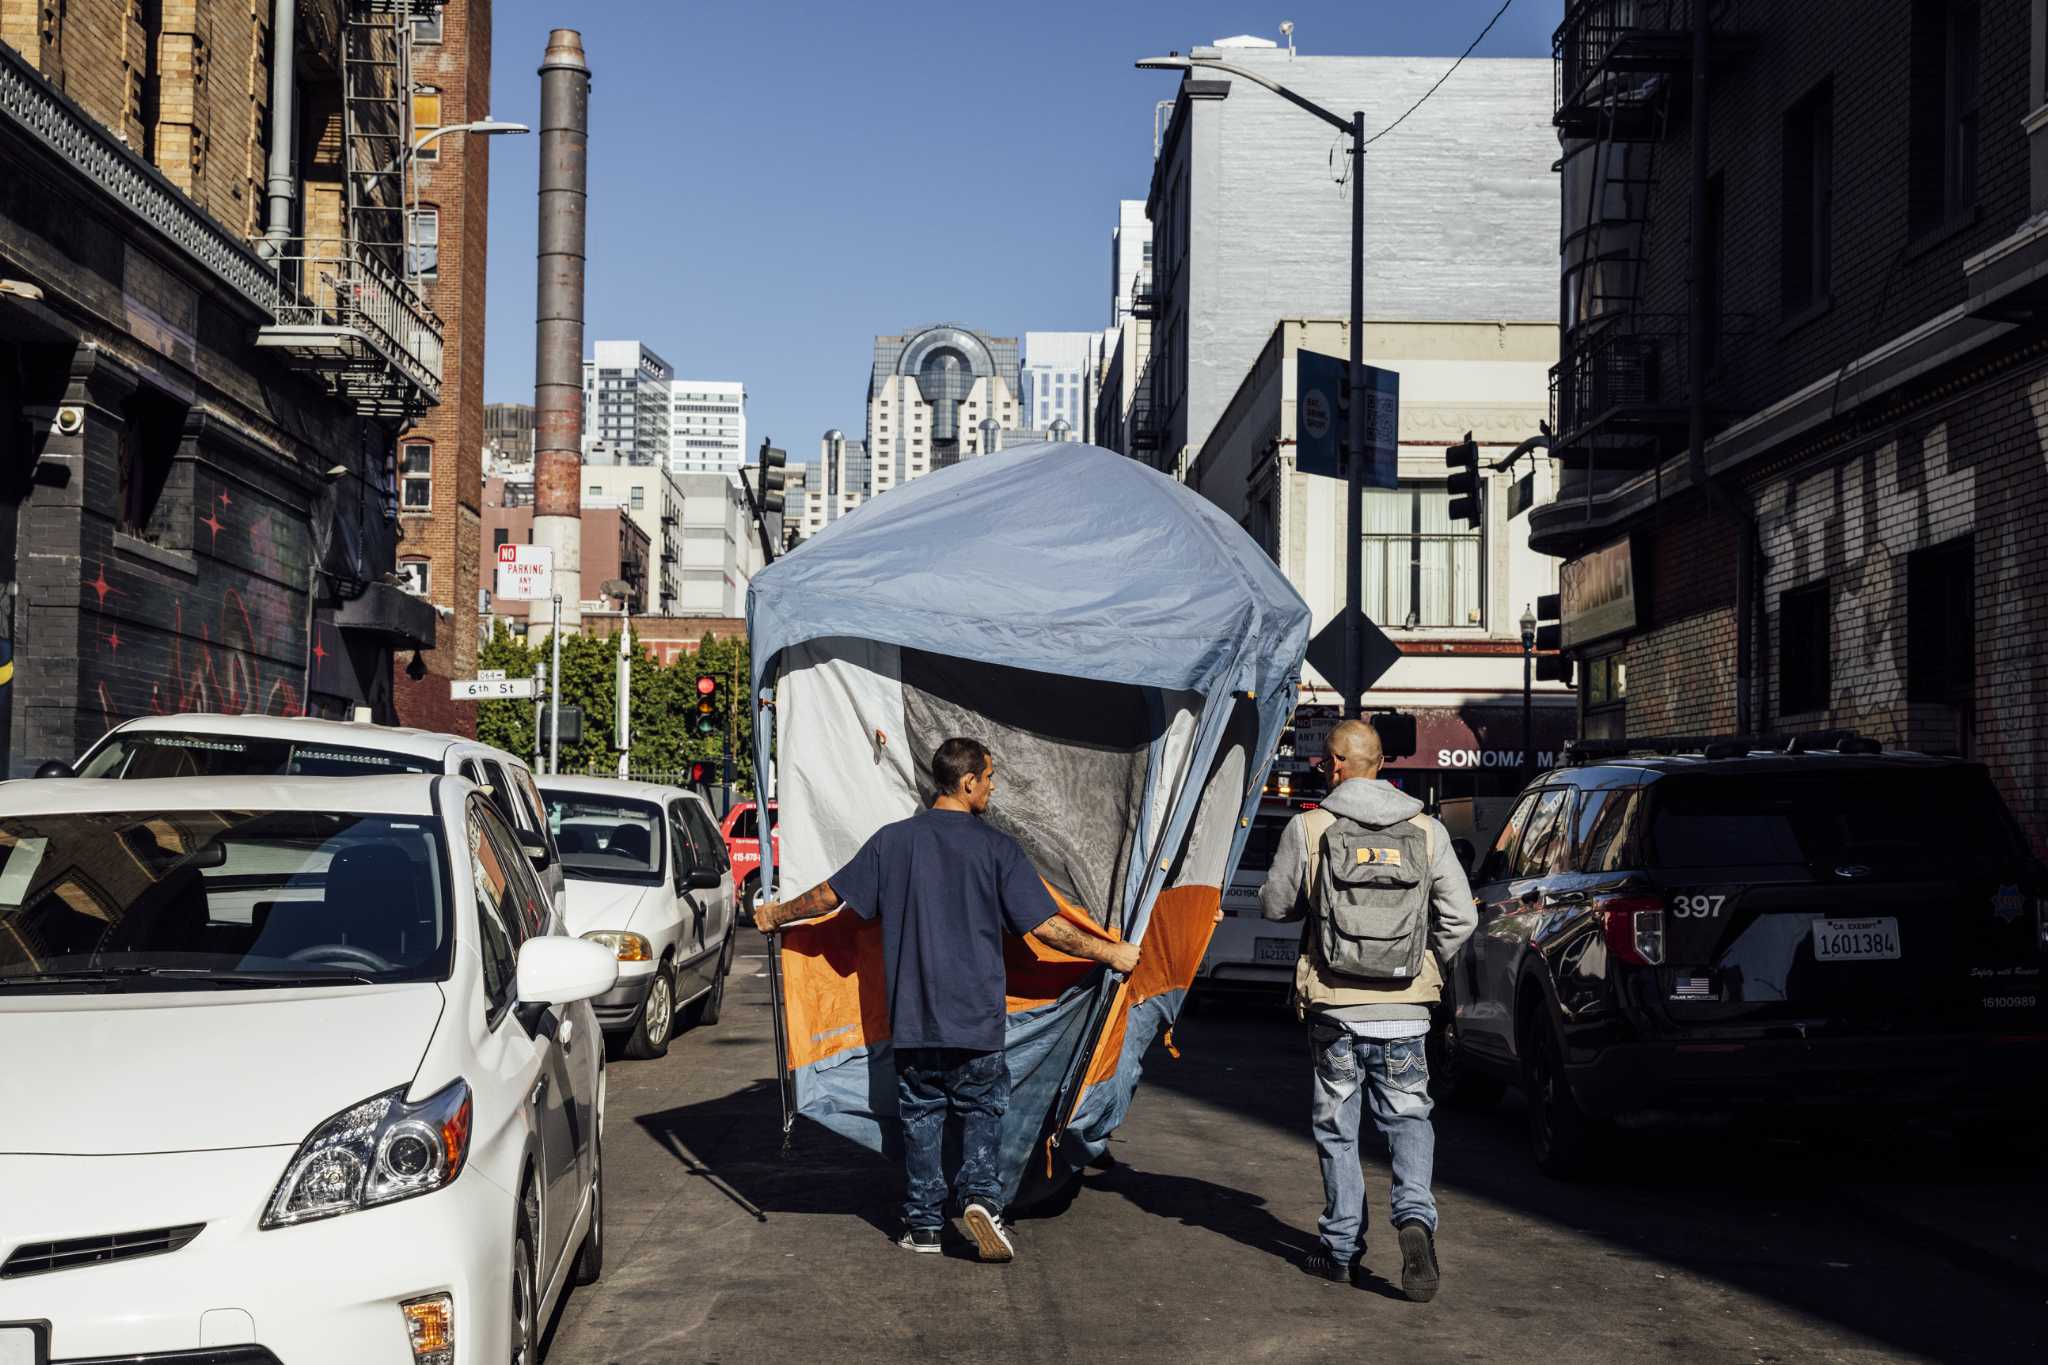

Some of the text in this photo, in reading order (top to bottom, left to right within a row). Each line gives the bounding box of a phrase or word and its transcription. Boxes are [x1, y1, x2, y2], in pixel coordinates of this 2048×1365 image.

[502, 547, 515, 561] NO
[508, 564, 544, 574] PARKING
[468, 682, 514, 695] 6th St
[1673, 895, 1726, 919] 397
[1820, 933, 1894, 955] 1601384
